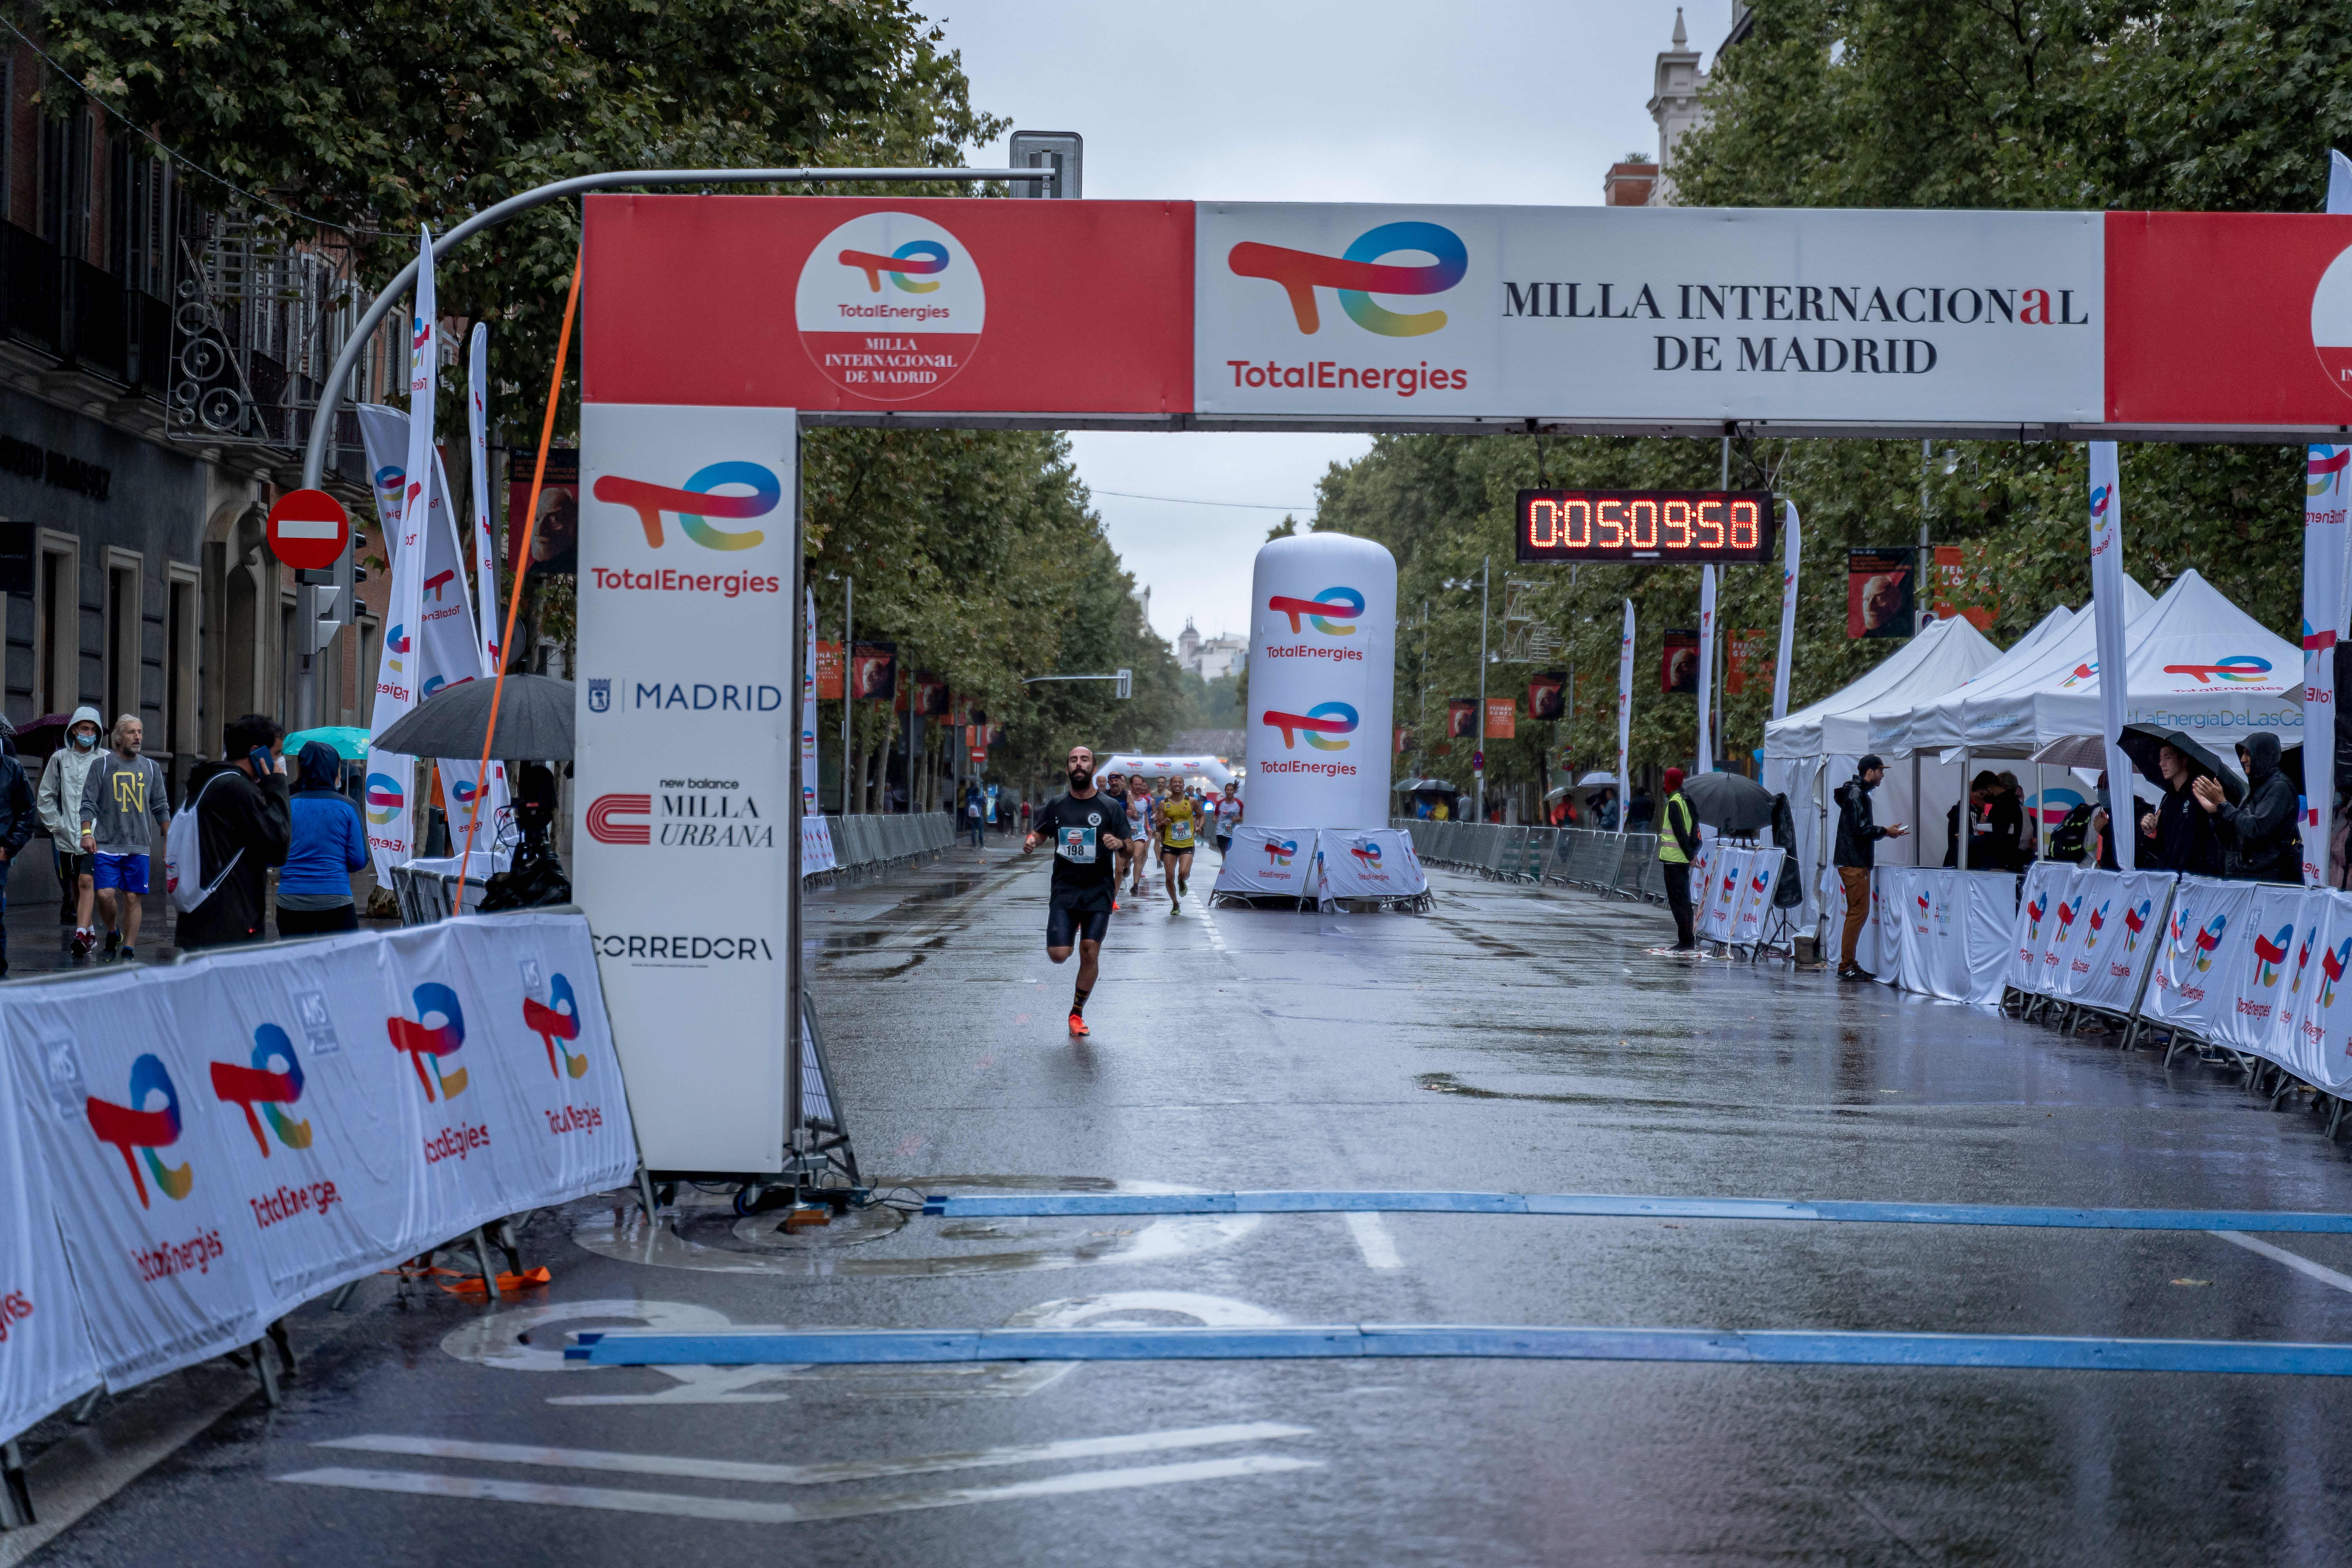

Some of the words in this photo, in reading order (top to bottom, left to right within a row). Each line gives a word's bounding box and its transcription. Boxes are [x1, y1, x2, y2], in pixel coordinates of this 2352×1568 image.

[1503, 282, 1665, 319] MILLA
[838, 304, 950, 321] TotalEnergies
[866, 338, 917, 351] MILLA
[1653, 336, 1721, 371] DE
[1737, 336, 1937, 374] MADRID
[846, 371, 867, 383] DE
[872, 371, 937, 384] MADRID
[1227, 360, 1467, 397] TotalEnergies
[591, 568, 779, 598] TotalEnergies
[1267, 645, 1362, 662] TotalEnergies
[636, 683, 781, 711] MADRID
[1260, 760, 1357, 777] TotalEnergies
[660, 779, 685, 789] new
[688, 778, 739, 789] balance
[662, 795, 759, 818] MILLA
[660, 824, 775, 848] URBANA
[1066, 845, 1084, 856] 198
[1259, 870, 1291, 880] TotalEnergies
